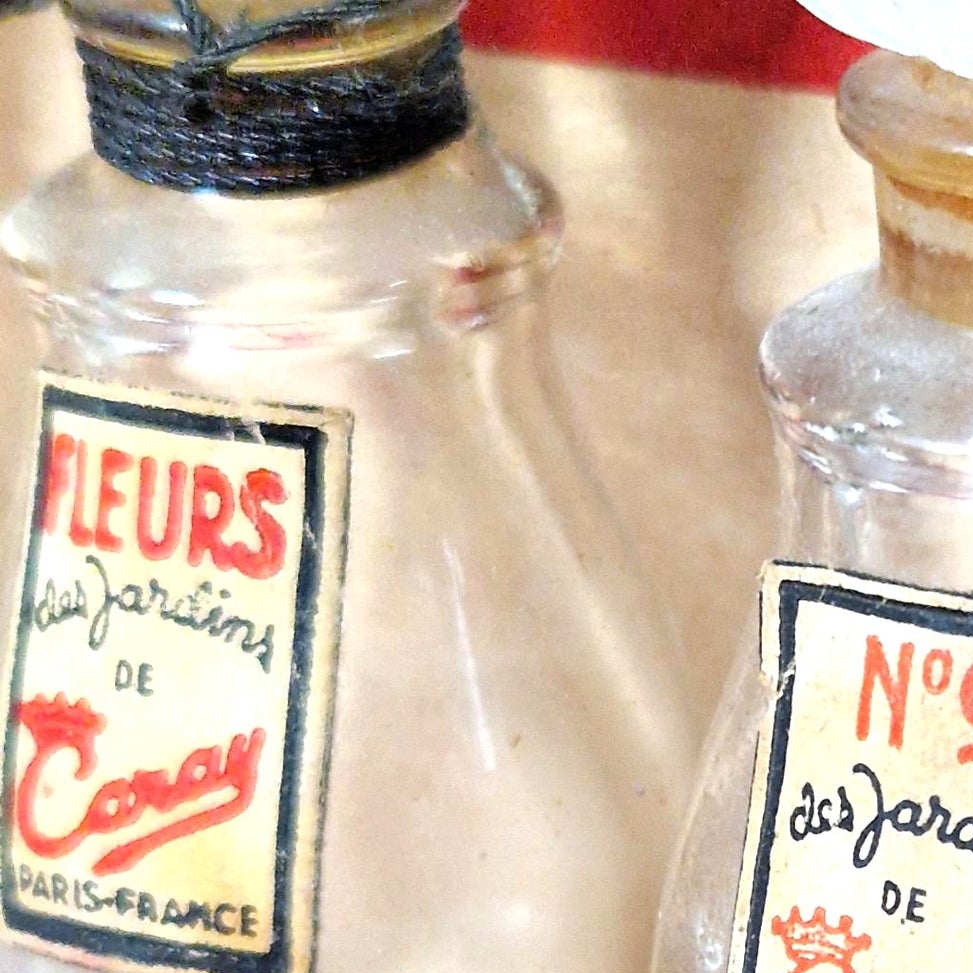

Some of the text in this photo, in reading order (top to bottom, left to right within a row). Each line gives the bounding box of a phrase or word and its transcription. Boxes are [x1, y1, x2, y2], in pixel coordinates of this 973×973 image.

[42, 433, 290, 580] FLEURS
[33, 554, 275, 674] des Jardins
[115, 659, 154, 696] DE
[789, 783, 854, 841] des
[882, 880, 927, 923] DE
